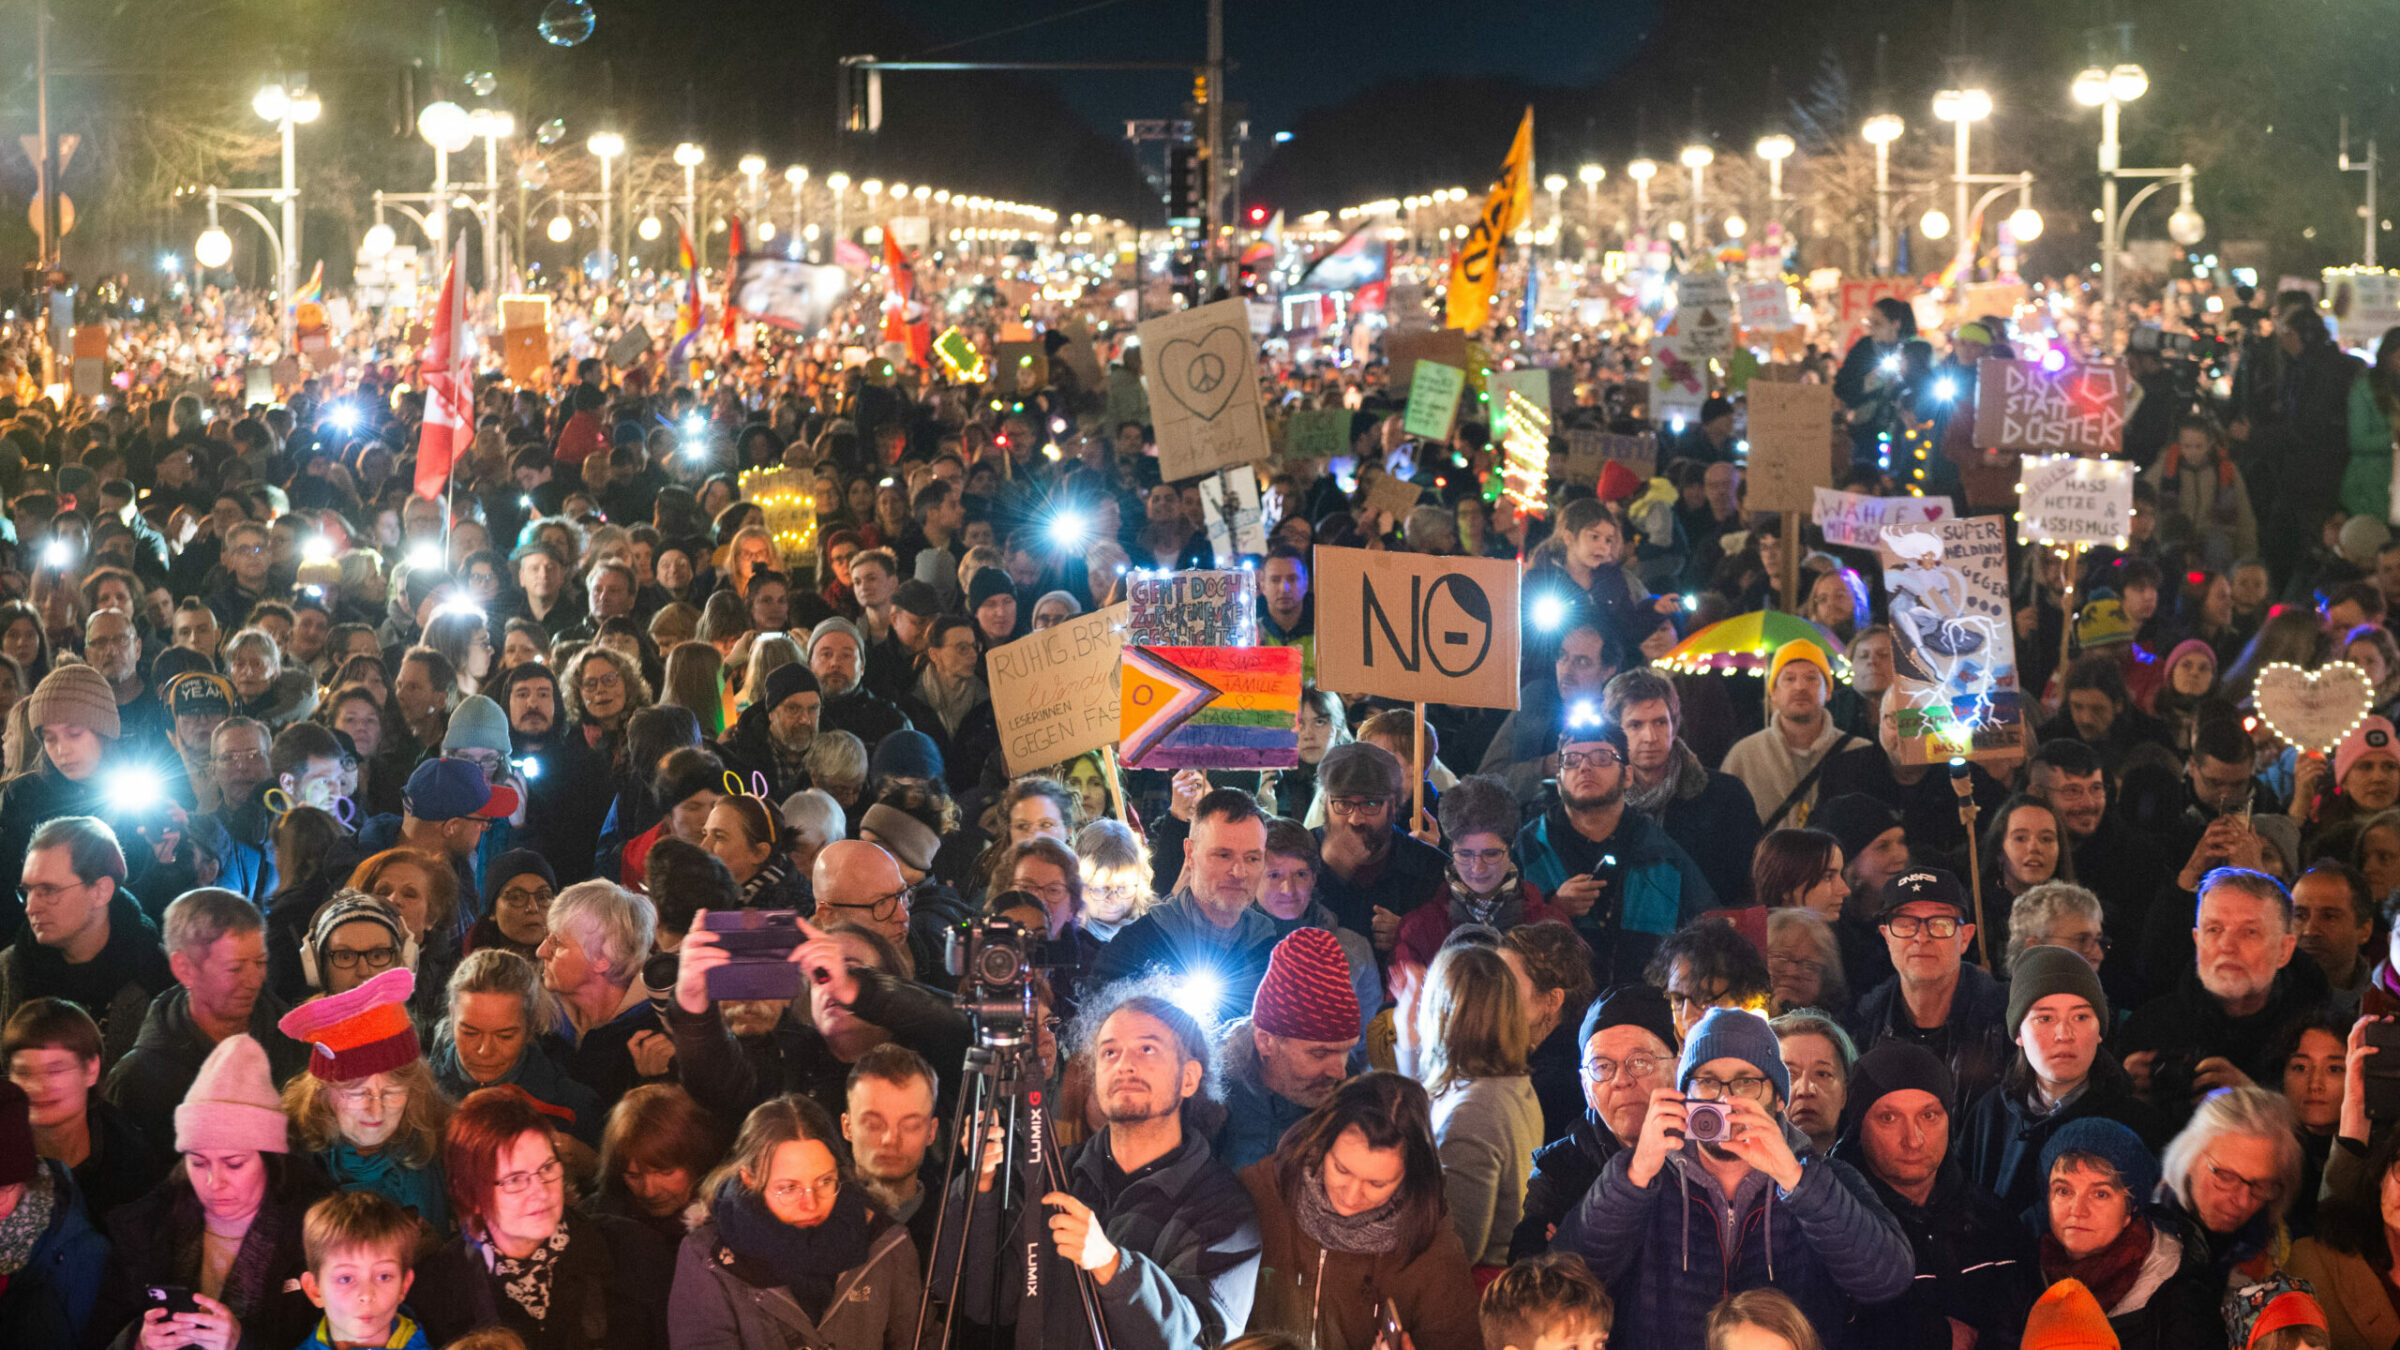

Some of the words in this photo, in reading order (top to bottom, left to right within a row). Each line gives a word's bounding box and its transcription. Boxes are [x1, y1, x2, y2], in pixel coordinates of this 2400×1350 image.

[2005, 393, 2068, 420] STATT
[2001, 406, 2123, 446] DÜSTER
[2065, 480, 2107, 493] HASS
[2044, 496, 2096, 510] HETZE
[2104, 501, 2117, 518] &
[2026, 516, 2120, 536] ASSISMUS
[1131, 577, 1187, 605] GEHT
[1191, 574, 1242, 604] DOCH
[1961, 565, 2010, 599] GEGEN
[1362, 571, 1493, 678] NO
[1180, 649, 1218, 669] WIR
[1229, 654, 1262, 670] SIND
[181, 685, 223, 701] YEAH
[1008, 701, 1073, 731] LESERINNEN
[1012, 719, 1075, 759] GEGEN
[1933, 743, 1964, 755] HASS
[1029, 1091, 1042, 1106] G
[1028, 1108, 1042, 1163] LUMIX
[1027, 1242, 1039, 1297] LUMIX
